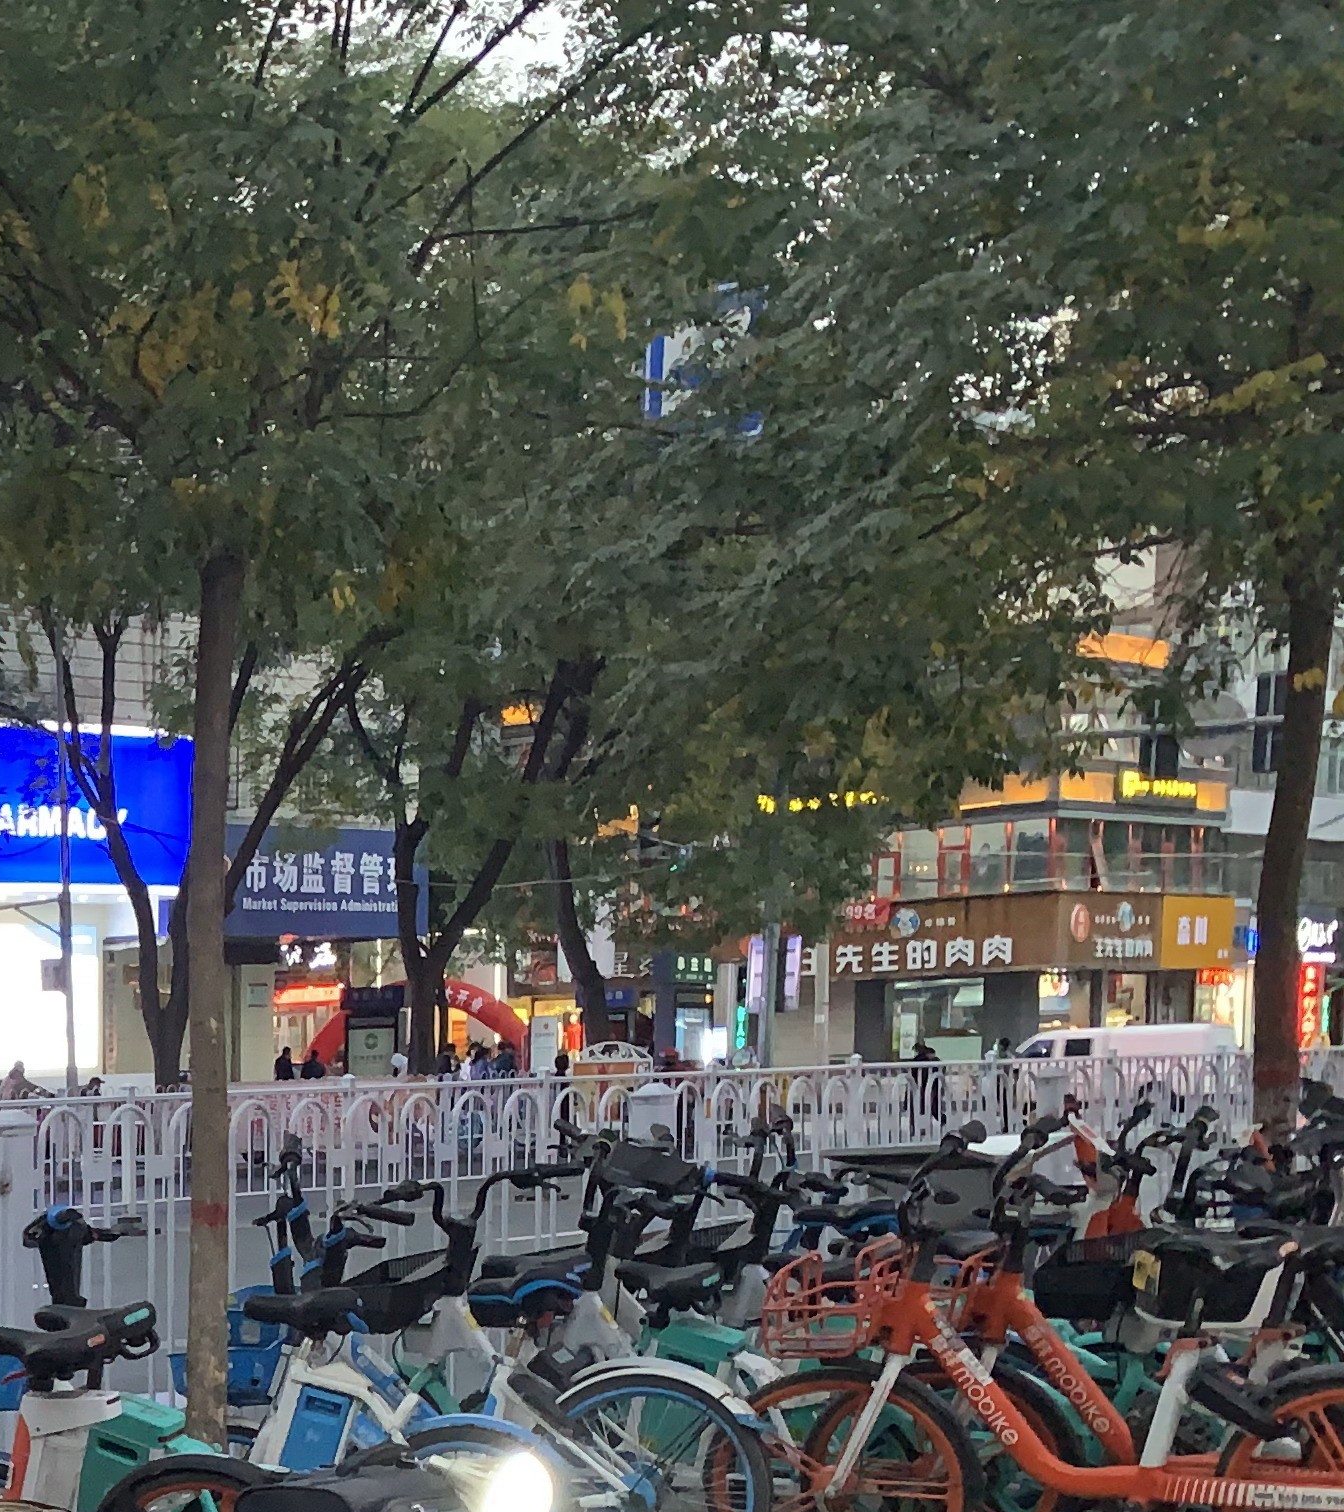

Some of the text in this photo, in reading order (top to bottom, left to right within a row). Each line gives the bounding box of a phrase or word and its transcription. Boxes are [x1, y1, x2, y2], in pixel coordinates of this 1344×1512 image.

[242, 896, 399, 913] Market Supervision Administrati
[953, 1366, 1019, 1446] mobike
[1045, 1357, 1110, 1434] mobike
